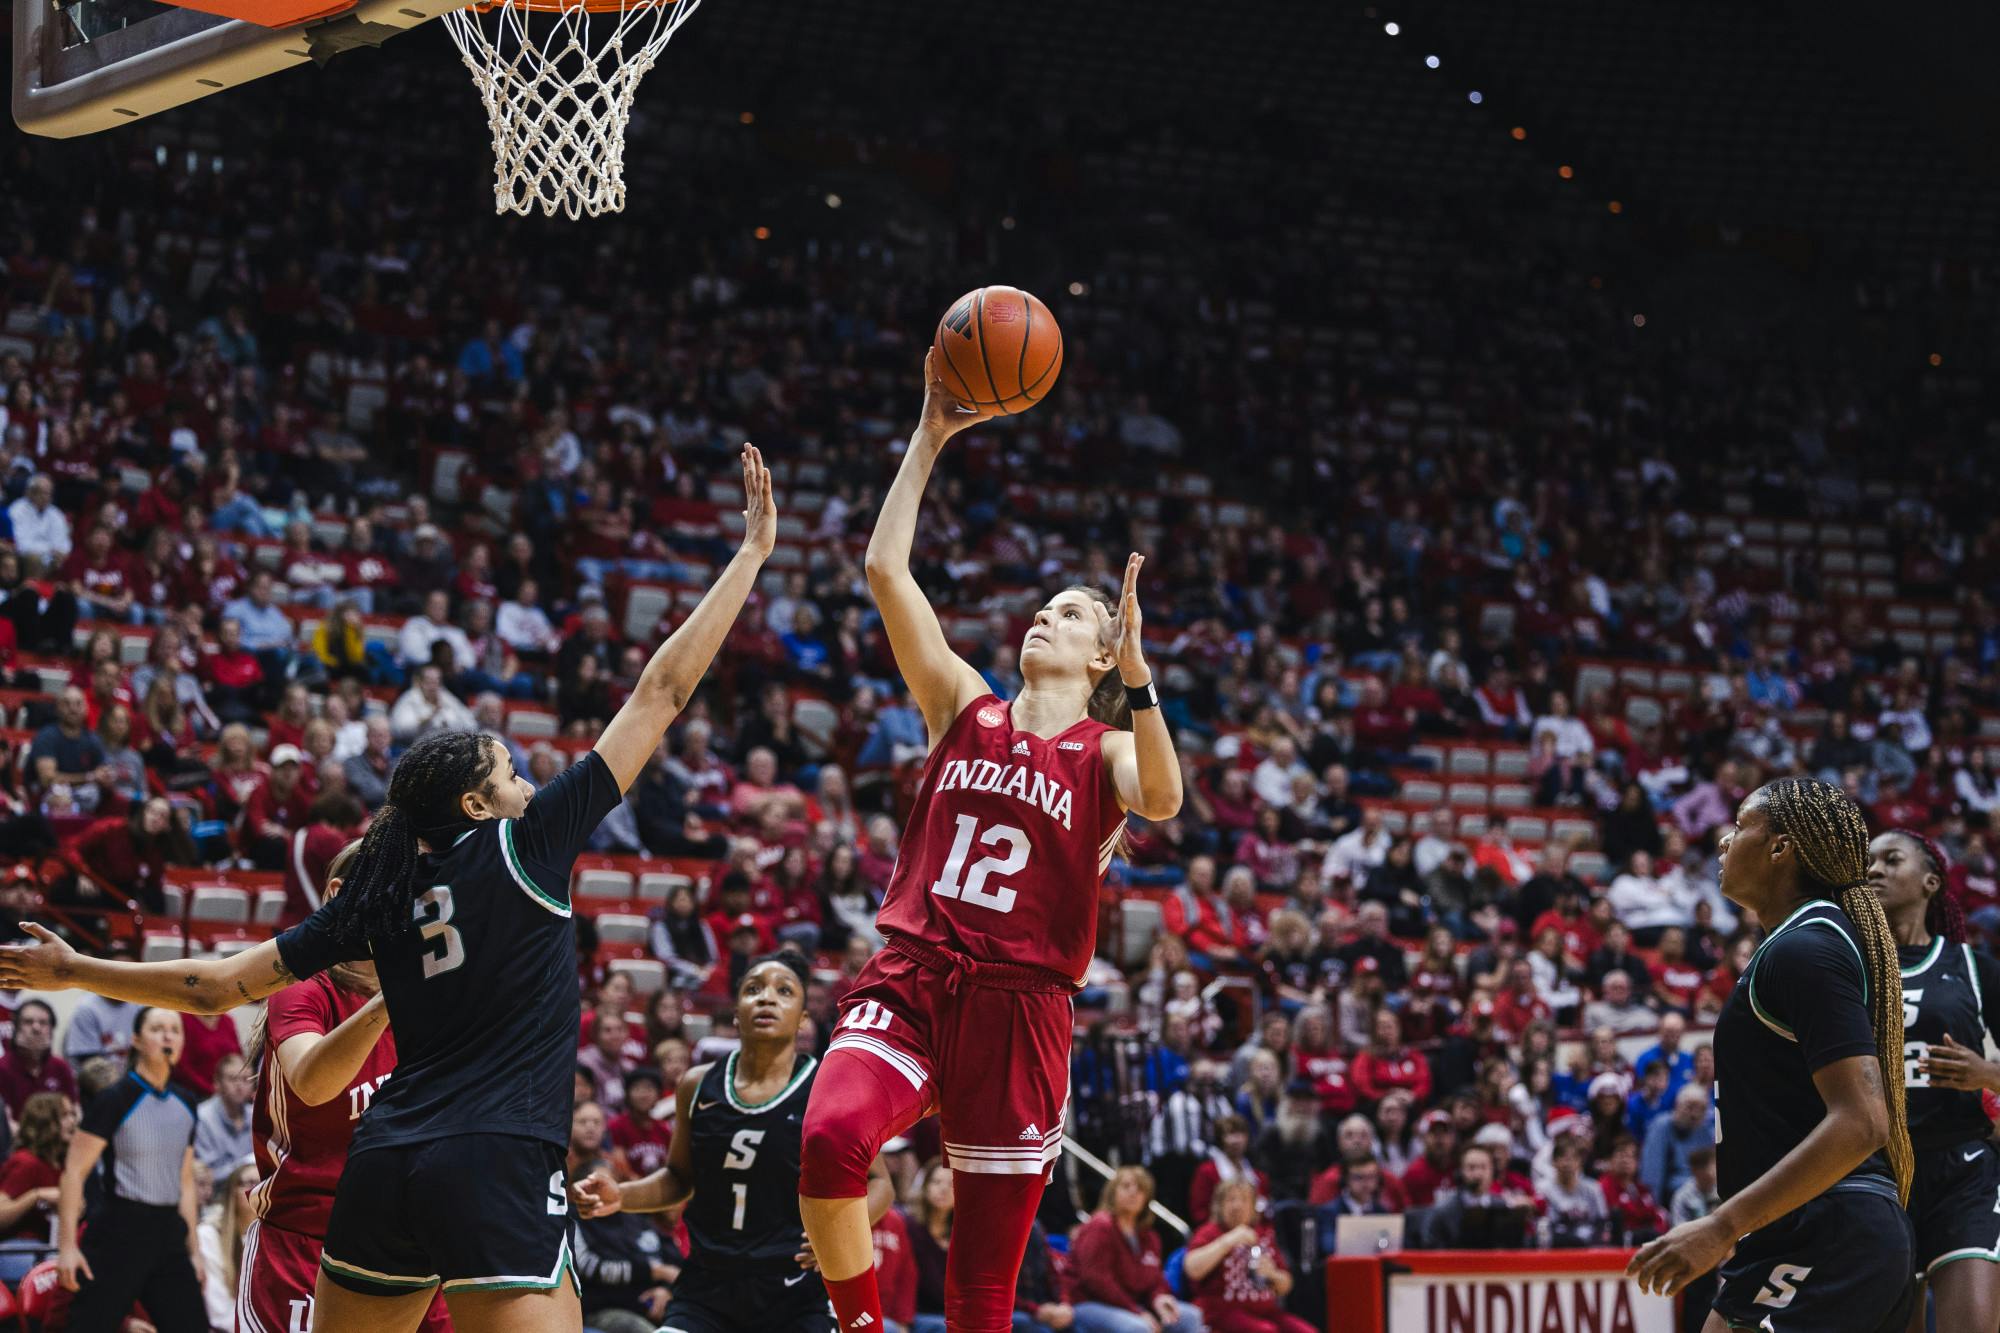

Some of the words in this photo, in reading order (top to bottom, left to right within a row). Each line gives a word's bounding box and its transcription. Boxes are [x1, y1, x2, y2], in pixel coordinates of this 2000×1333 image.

[935, 759, 1073, 832] INDIANA
[930, 813, 1032, 914] 12
[413, 884, 467, 980] 3
[723, 1130, 766, 1170] S
[1018, 1133, 1044, 1141] adidas
[732, 1184, 747, 1230] 1
[1425, 1280, 1640, 1333] INDIANA
[1752, 1263, 1813, 1309] S
